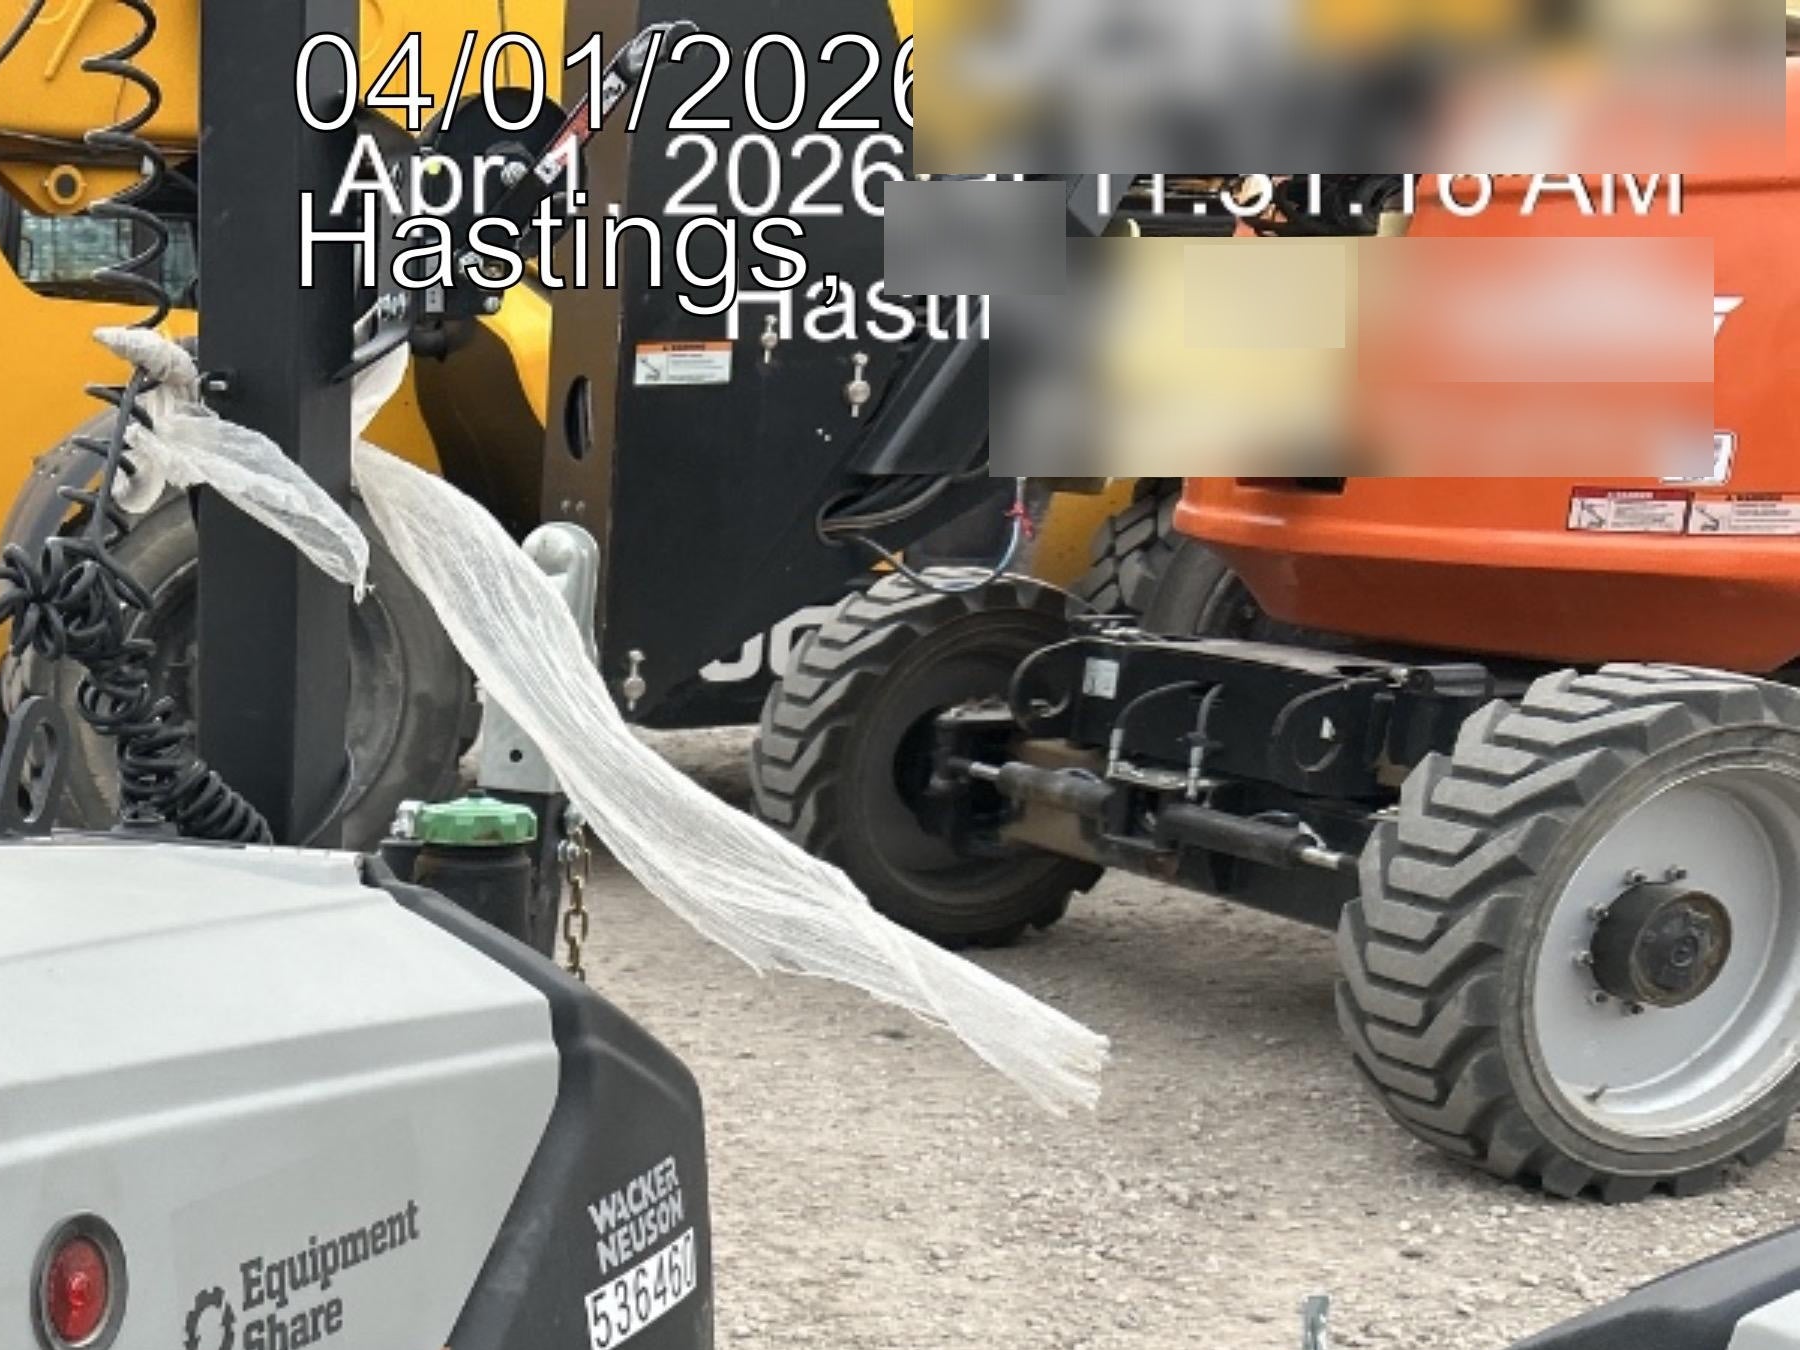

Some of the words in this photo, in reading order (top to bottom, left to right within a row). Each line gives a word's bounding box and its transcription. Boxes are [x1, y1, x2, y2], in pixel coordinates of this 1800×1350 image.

[587, 1154, 680, 1235] WACKER
[596, 1187, 685, 1276] NEUSON
[240, 1199, 419, 1312] Equipment
[592, 1232, 695, 1348] 536460
